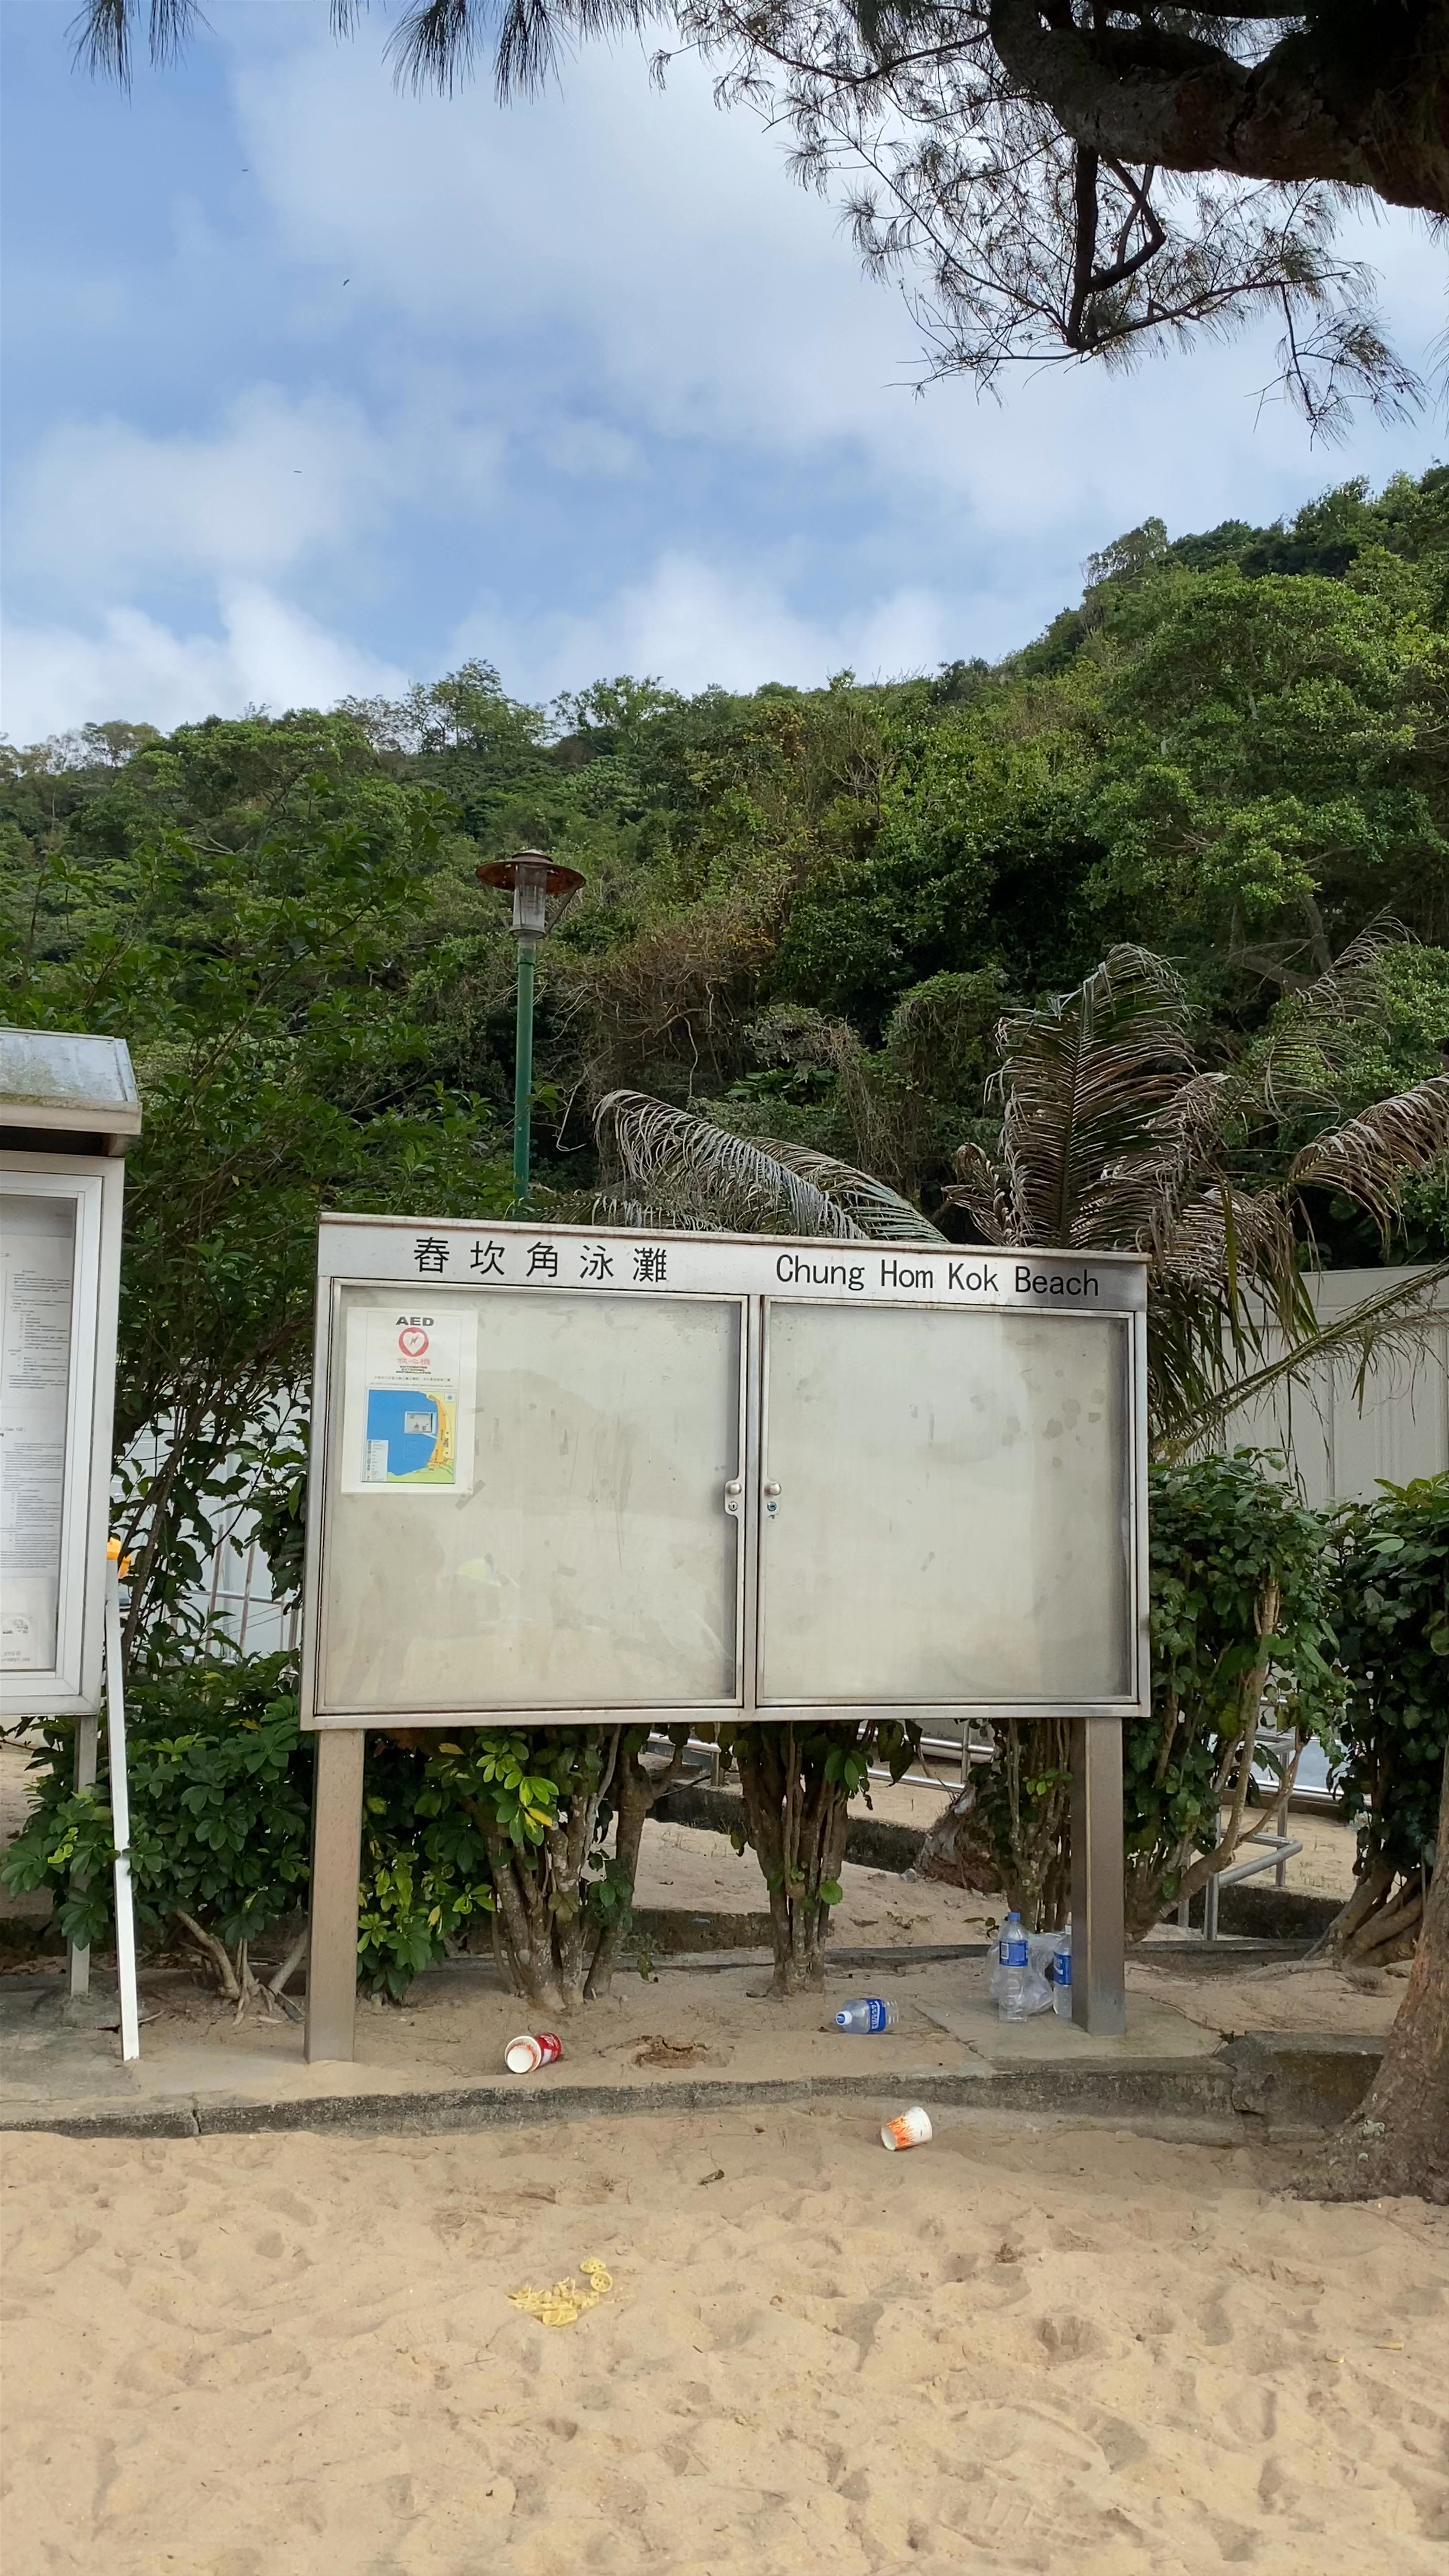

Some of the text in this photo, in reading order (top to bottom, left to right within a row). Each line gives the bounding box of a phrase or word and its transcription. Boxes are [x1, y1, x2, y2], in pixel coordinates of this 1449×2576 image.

[414, 1236, 667, 1283] 舂坎角泳灘
[776, 1254, 1098, 1296] Chung Hom Kok Beach
[395, 1316, 434, 1326] AED
